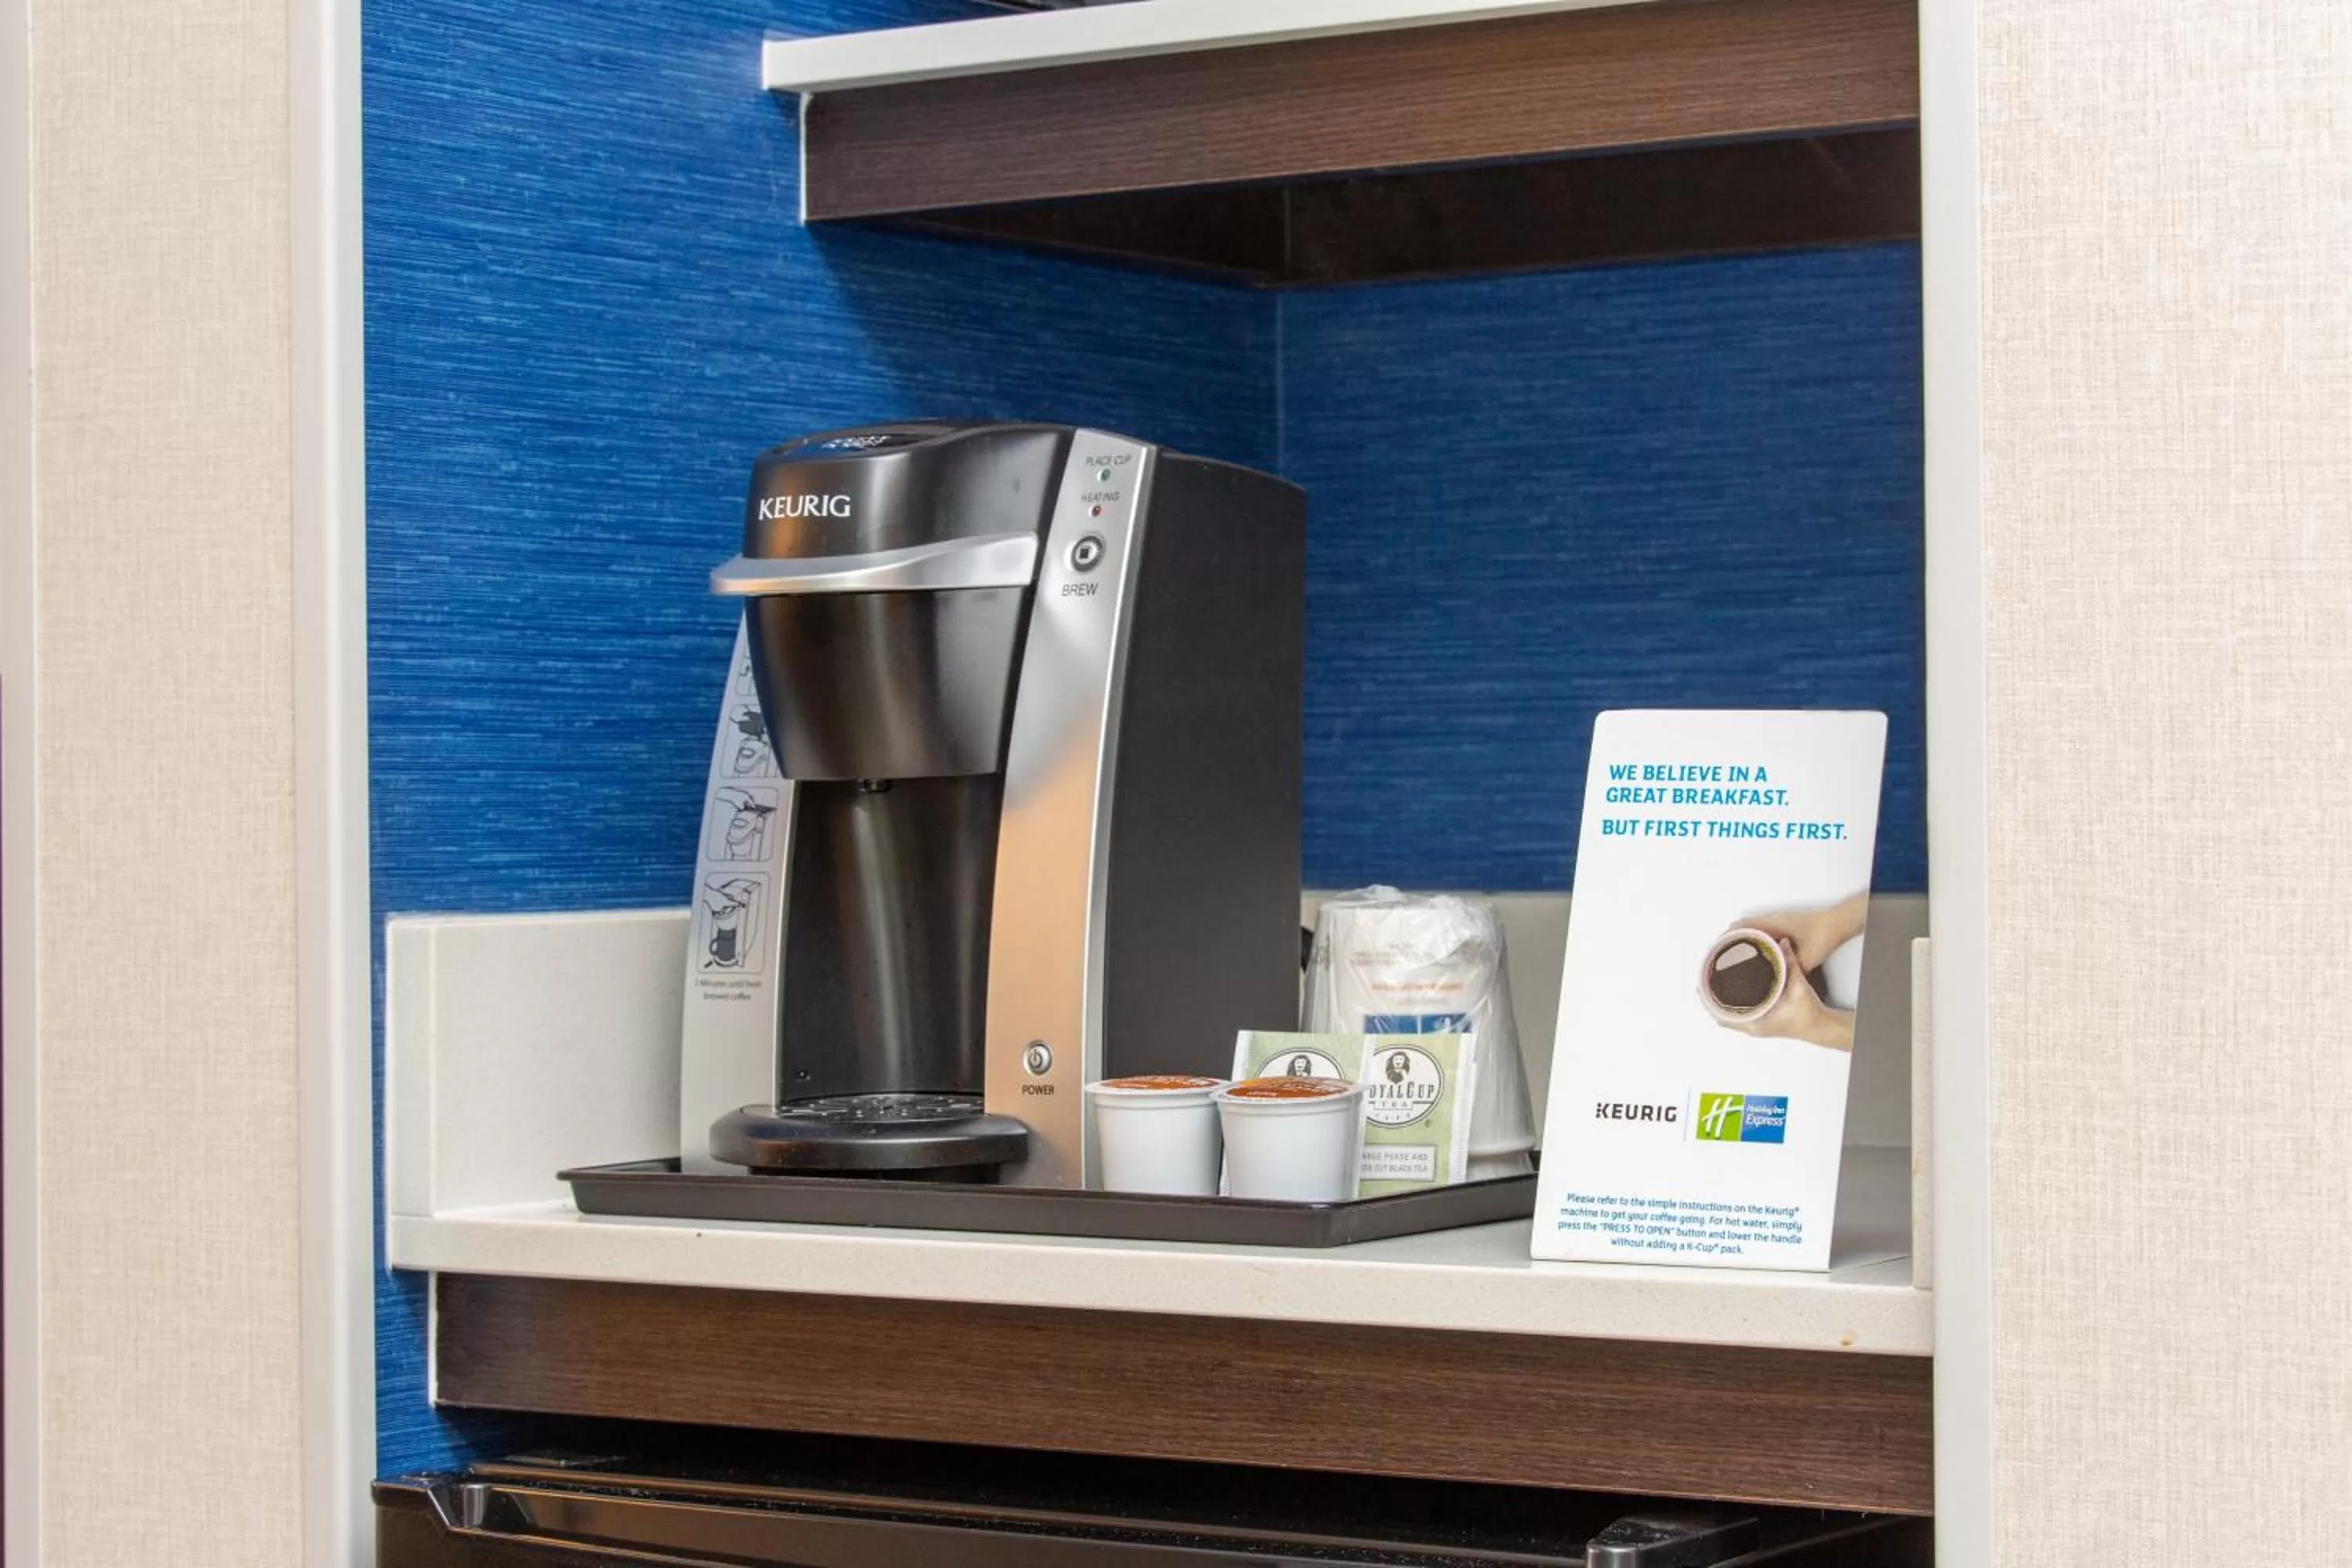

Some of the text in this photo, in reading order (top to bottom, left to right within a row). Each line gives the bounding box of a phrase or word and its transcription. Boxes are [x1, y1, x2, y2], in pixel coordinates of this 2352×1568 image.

[1080, 492, 1120, 503] HEATING
[759, 495, 852, 521] KEURIG
[1062, 583, 1098, 597] BREW
[1610, 764, 1768, 782] WE BELIEVE IN A
[1606, 786, 1789, 806] GREAT BREAKFAST.
[1602, 819, 1848, 840] BUT FIRST THINGS FIRST.
[1022, 1084, 1054, 1095] POWER
[1595, 1102, 1678, 1123] KEURIG
[1745, 1113, 1784, 1127] Express
[1567, 1192, 1595, 1203] Please
[1597, 1195, 1617, 1205] refer
[1620, 1196, 1628, 1206] to
[1631, 1196, 1645, 1207] the
[1648, 1197, 1677, 1210] simple
[1679, 1200, 1732, 1213] instructions
[1733, 1204, 1746, 1213] on
[1748, 1203, 1762, 1214] the
[1560, 1207, 1598, 1218] machine
[1600, 1208, 1610, 1218] to
[1612, 1210, 1625, 1220] get
[1628, 1212, 1647, 1221] your
[1650, 1211, 1678, 1222] coffee
[1709, 1216, 1723, 1225] For
[1726, 1216, 1740, 1226] hot
[1741, 1218, 1769, 1229] water,
[1771, 1220, 1802, 1232] simply
[1558, 1221, 1581, 1230] press
[1583, 1221, 1597, 1231] the
[1634, 1224, 1645, 1234] TO
[1676, 1227, 1706, 1238] button
[1708, 1229, 1726, 1239] and
[1727, 1230, 1751, 1241] lower
[1754, 1232, 1769, 1243] the
[1770, 1233, 1802, 1244] handle
[1610, 1237, 1644, 1248] without
[1646, 1239, 1677, 1251] adding
[1720, 1243, 1744, 1254] pack.
